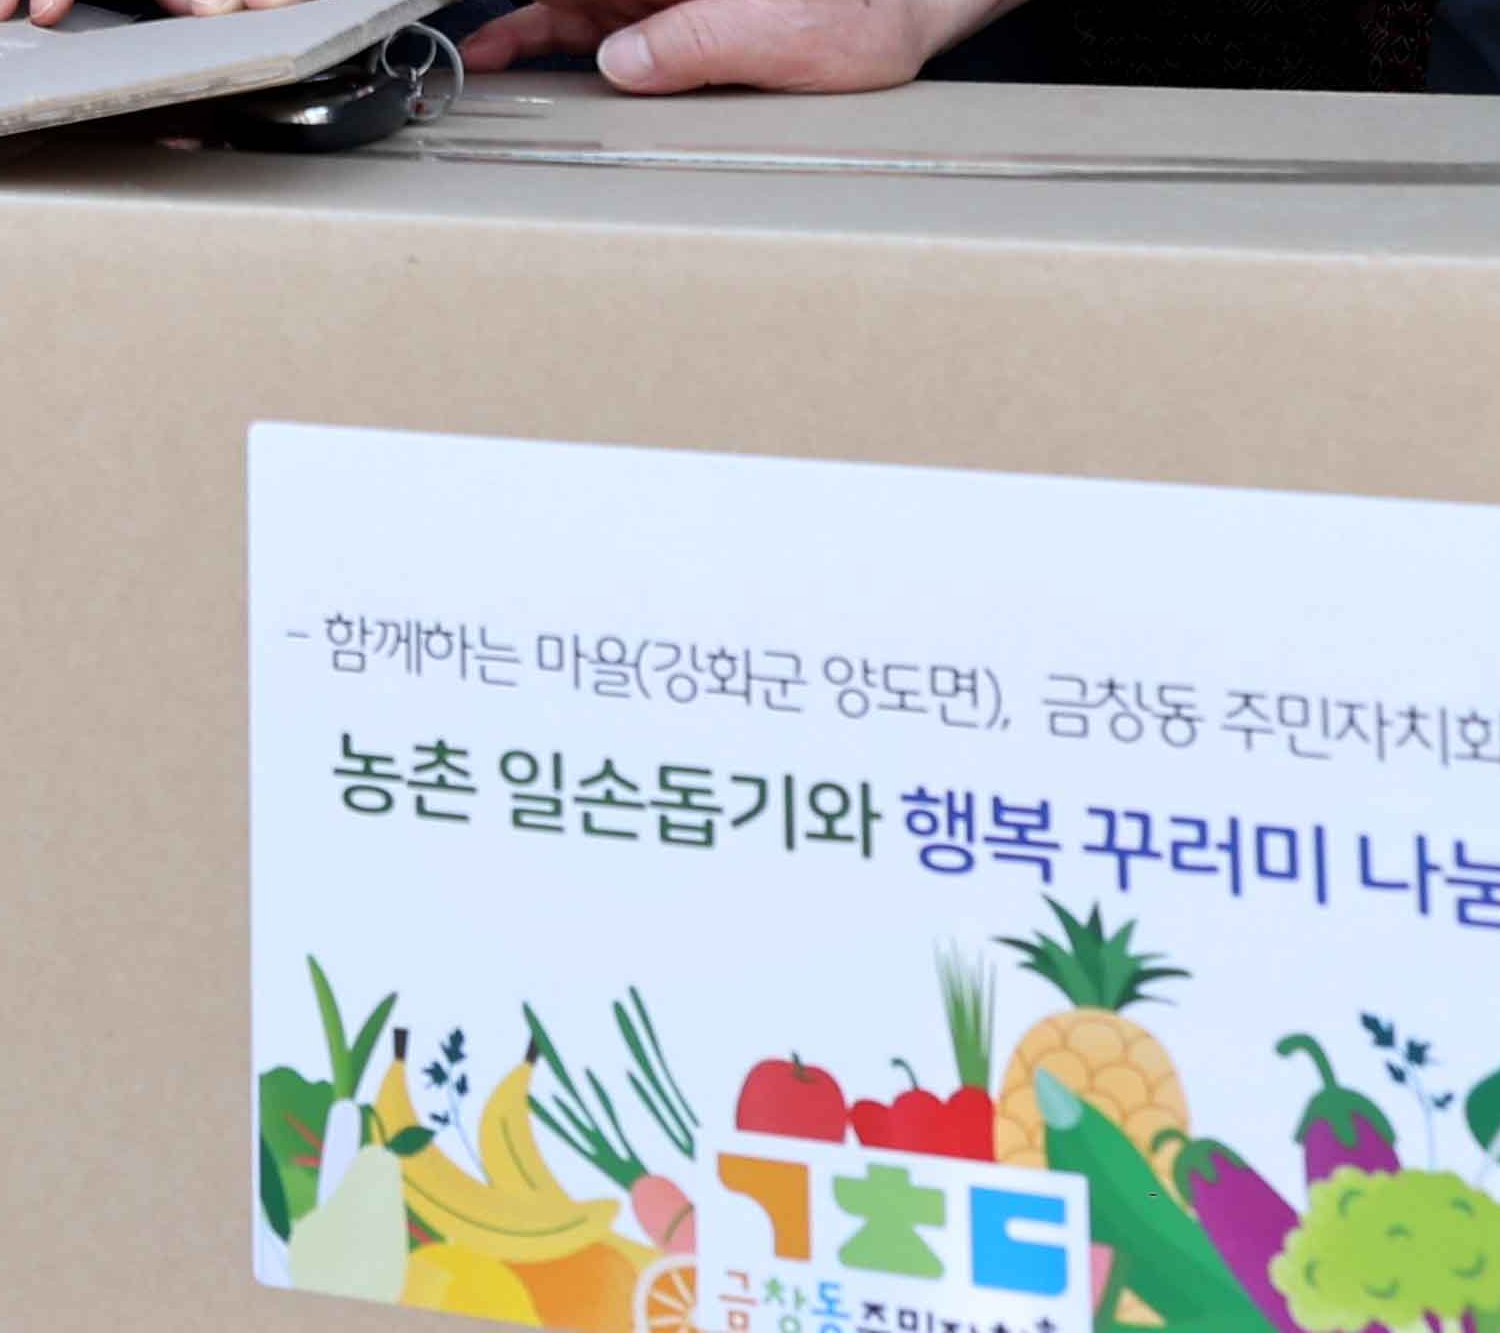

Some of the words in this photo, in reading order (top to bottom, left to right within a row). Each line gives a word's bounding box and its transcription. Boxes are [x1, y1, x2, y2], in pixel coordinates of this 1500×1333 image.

[324, 612, 521, 687] 함께하는
[536, 633, 808, 713] 마을(강화군
[1042, 673, 1204, 748] 금창동
[333, 732, 478, 822] 농촌
[499, 749, 883, 859] 일손돕기와
[900, 785, 1061, 885] 행복
[1082, 806, 1328, 906] 꾸러미
